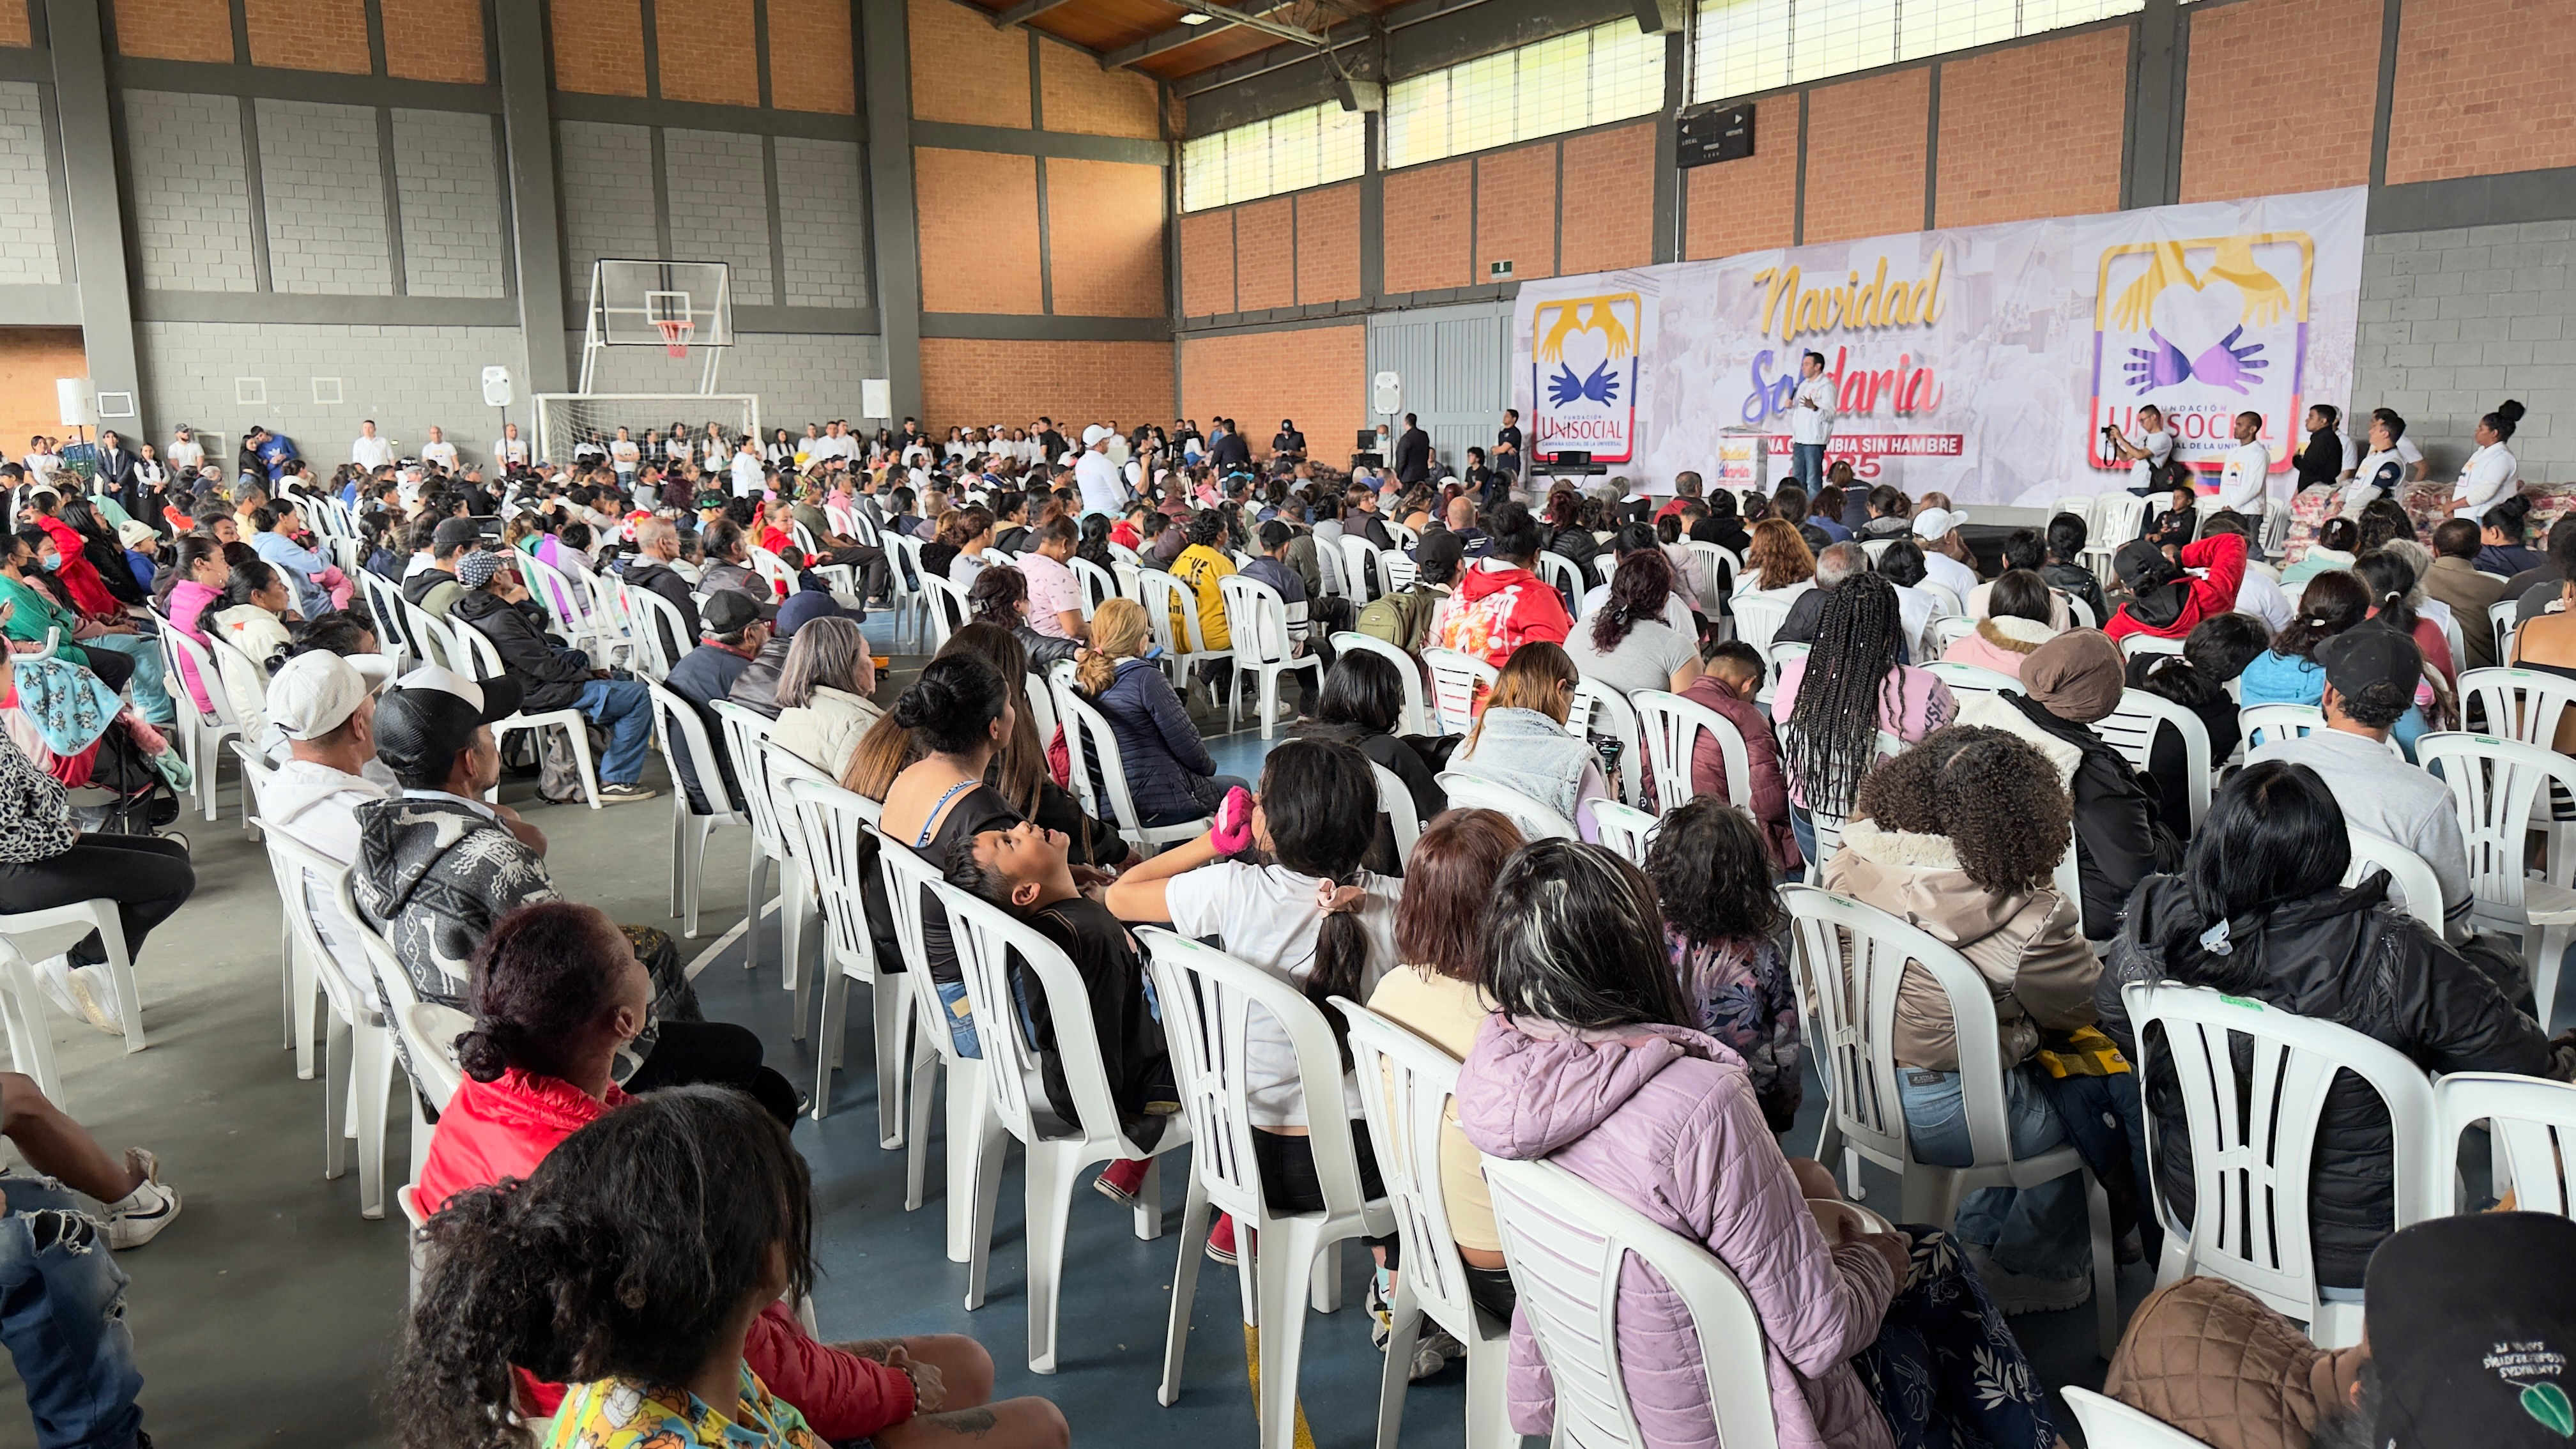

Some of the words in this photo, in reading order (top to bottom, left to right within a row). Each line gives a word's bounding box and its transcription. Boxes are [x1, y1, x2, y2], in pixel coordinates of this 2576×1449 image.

[1753, 250, 1946, 341] Navidad
[1742, 346, 1943, 422] Soldaria
[1542, 417, 1623, 439] UNISOCIAL
[1767, 438, 1784, 453] NA
[1786, 438, 1858, 453] CMBIA
[1862, 438, 1888, 452] SIN
[1890, 438, 1957, 453] HAMBRE
